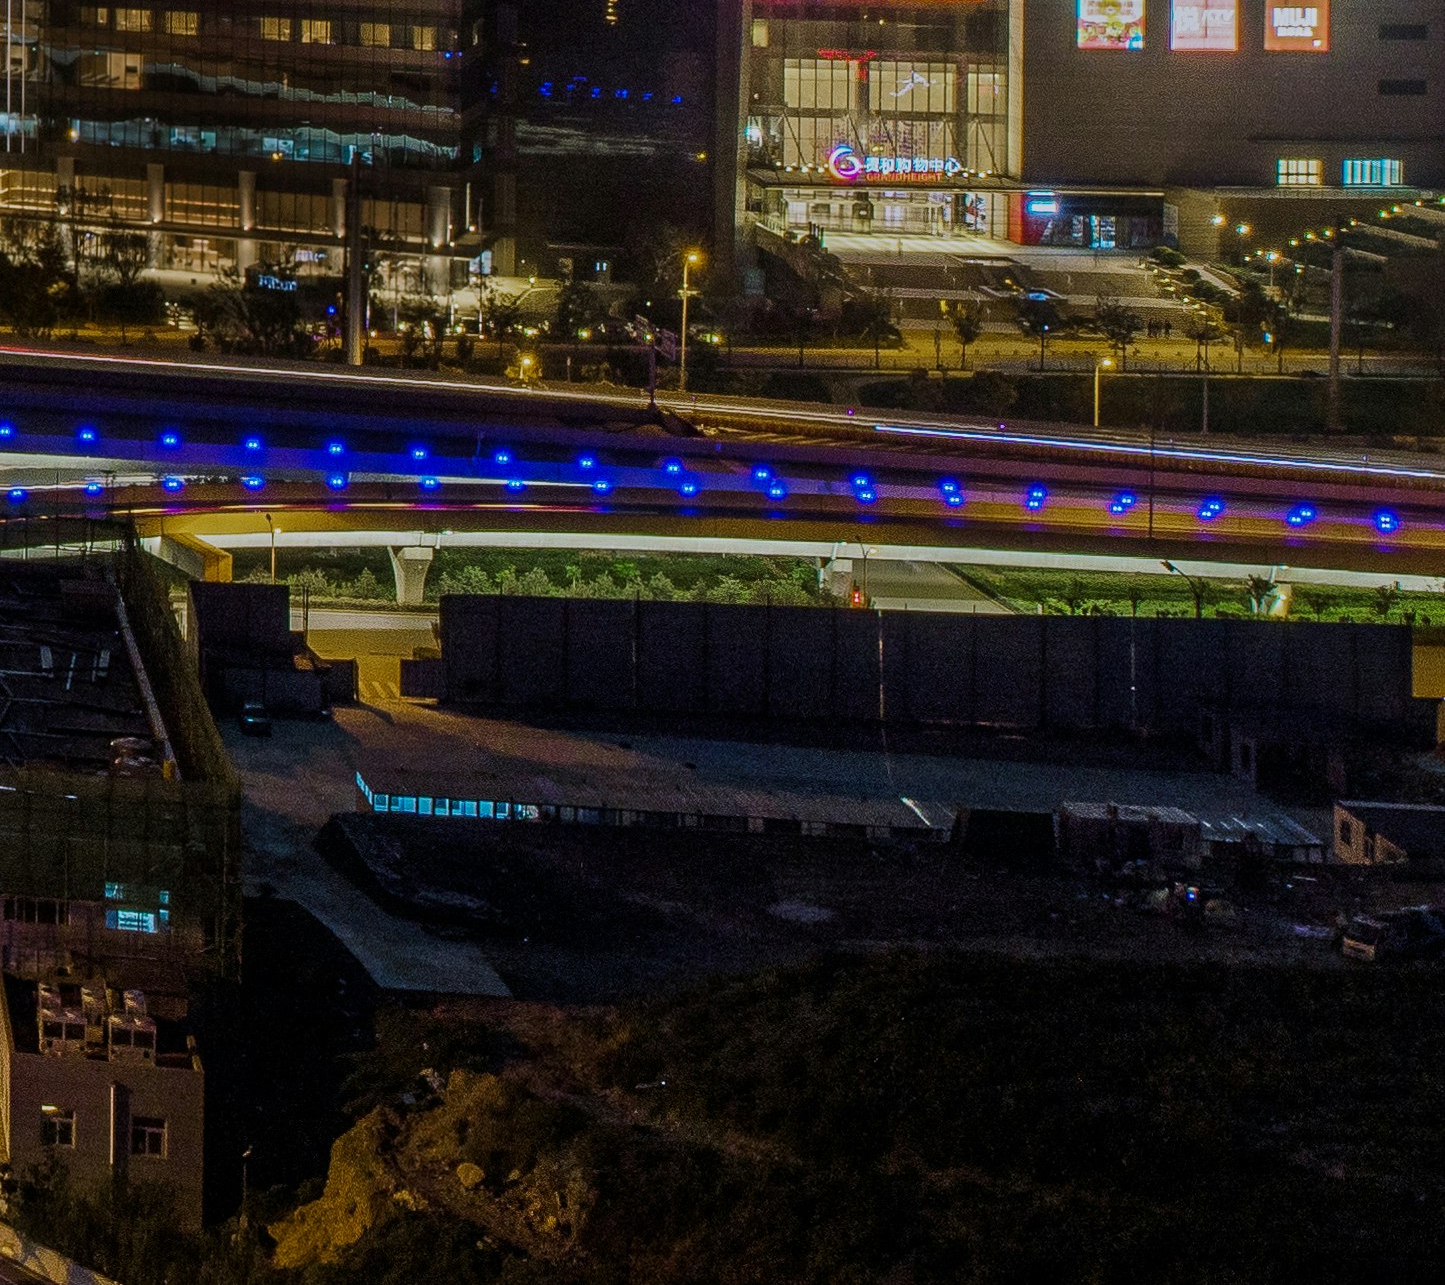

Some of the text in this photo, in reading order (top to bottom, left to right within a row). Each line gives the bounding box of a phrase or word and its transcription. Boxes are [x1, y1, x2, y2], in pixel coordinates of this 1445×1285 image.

[1273, 7, 1318, 27] MUJI
[864, 157, 962, 174] 贵和购物中心
[866, 172, 944, 183] GRANDHEIGHT
